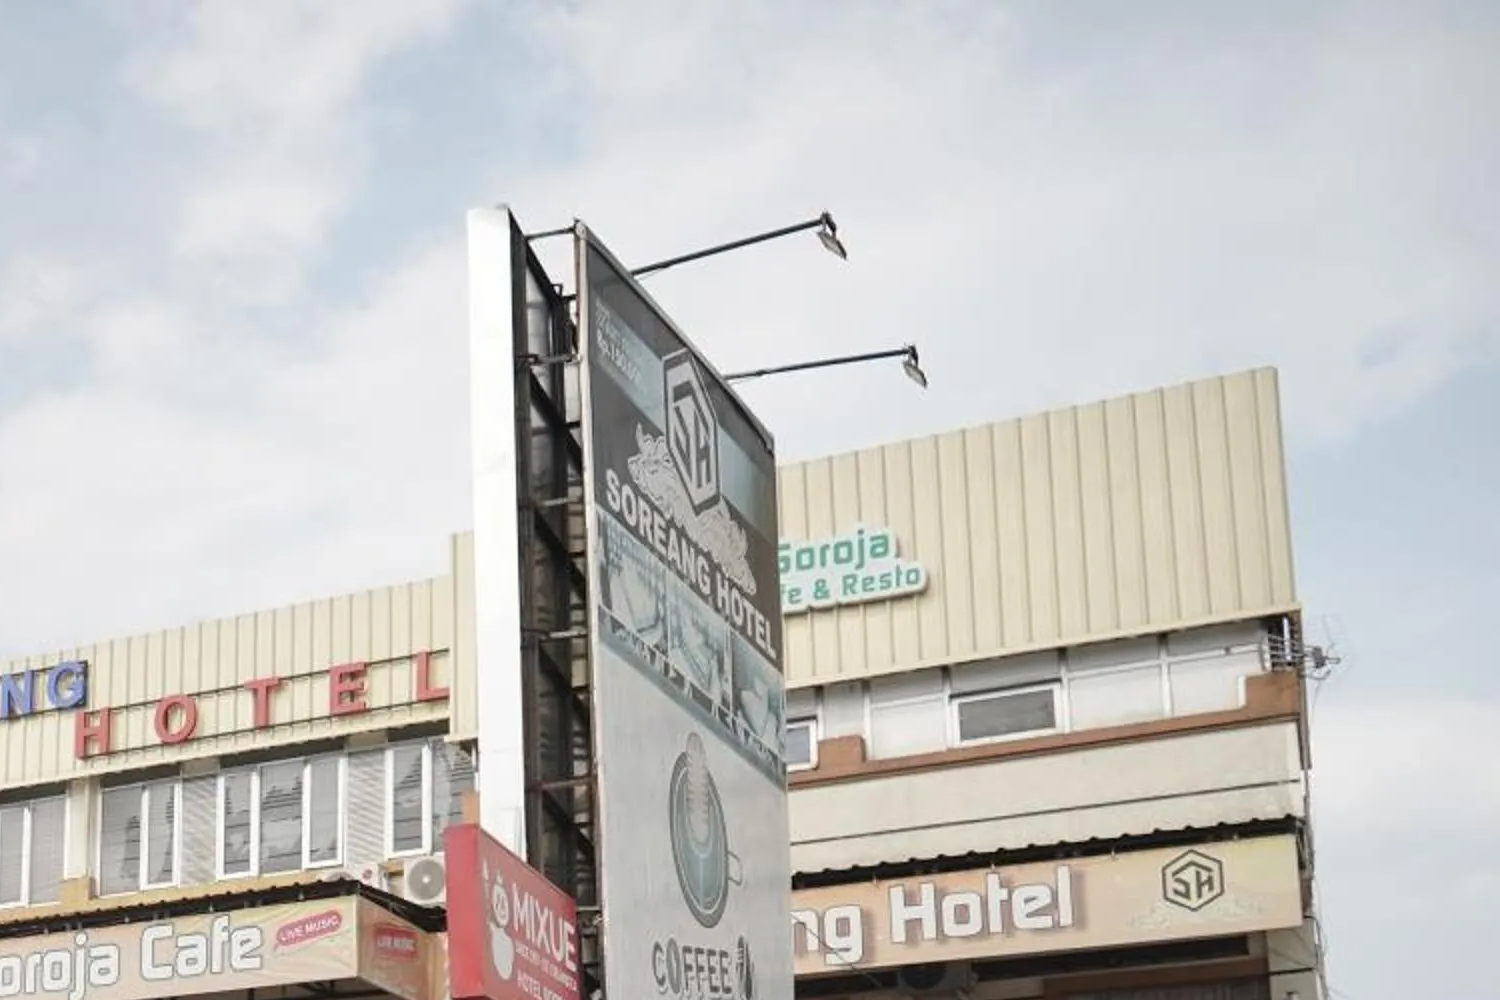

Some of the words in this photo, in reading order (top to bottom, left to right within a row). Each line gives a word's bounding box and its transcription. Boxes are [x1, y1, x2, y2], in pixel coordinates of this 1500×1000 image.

[605, 468, 712, 594] SOREANG
[716, 573, 777, 660] HOTEL
[778, 528, 890, 574] Soroja
[813, 578, 830, 601] &
[842, 565, 920, 596] Resto
[75, 650, 450, 761] HOTEL
[280, 926, 303, 943] LIVE
[304, 914, 342, 937] MUSIC
[511, 882, 578, 973] MIXUE
[889, 864, 1074, 945] Hotel
[140, 914, 264, 982] Cafe
